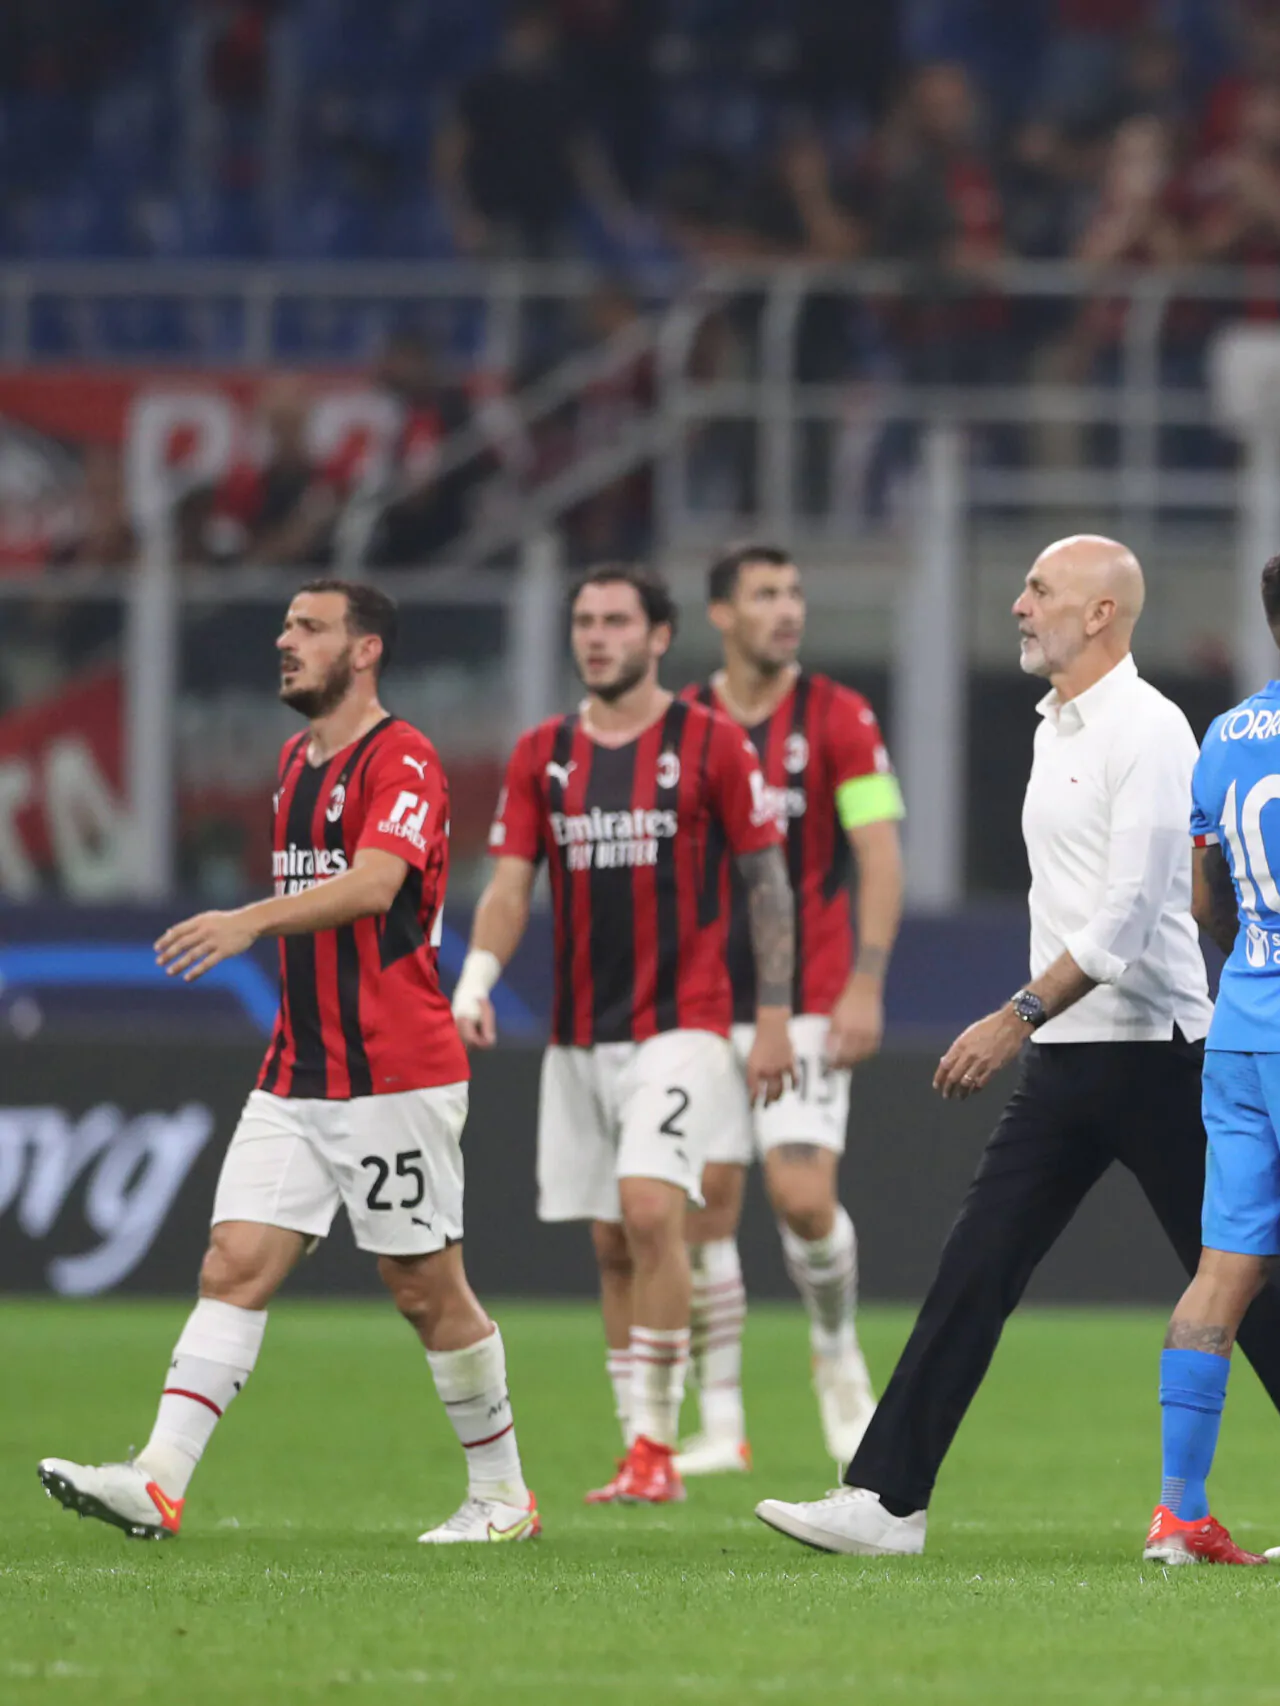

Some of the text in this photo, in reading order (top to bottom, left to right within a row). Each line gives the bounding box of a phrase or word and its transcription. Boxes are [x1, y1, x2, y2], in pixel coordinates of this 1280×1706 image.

[272, 842, 349, 876] mirates
[659, 1086, 690, 1137] 2
[360, 1149, 425, 1211] 25
